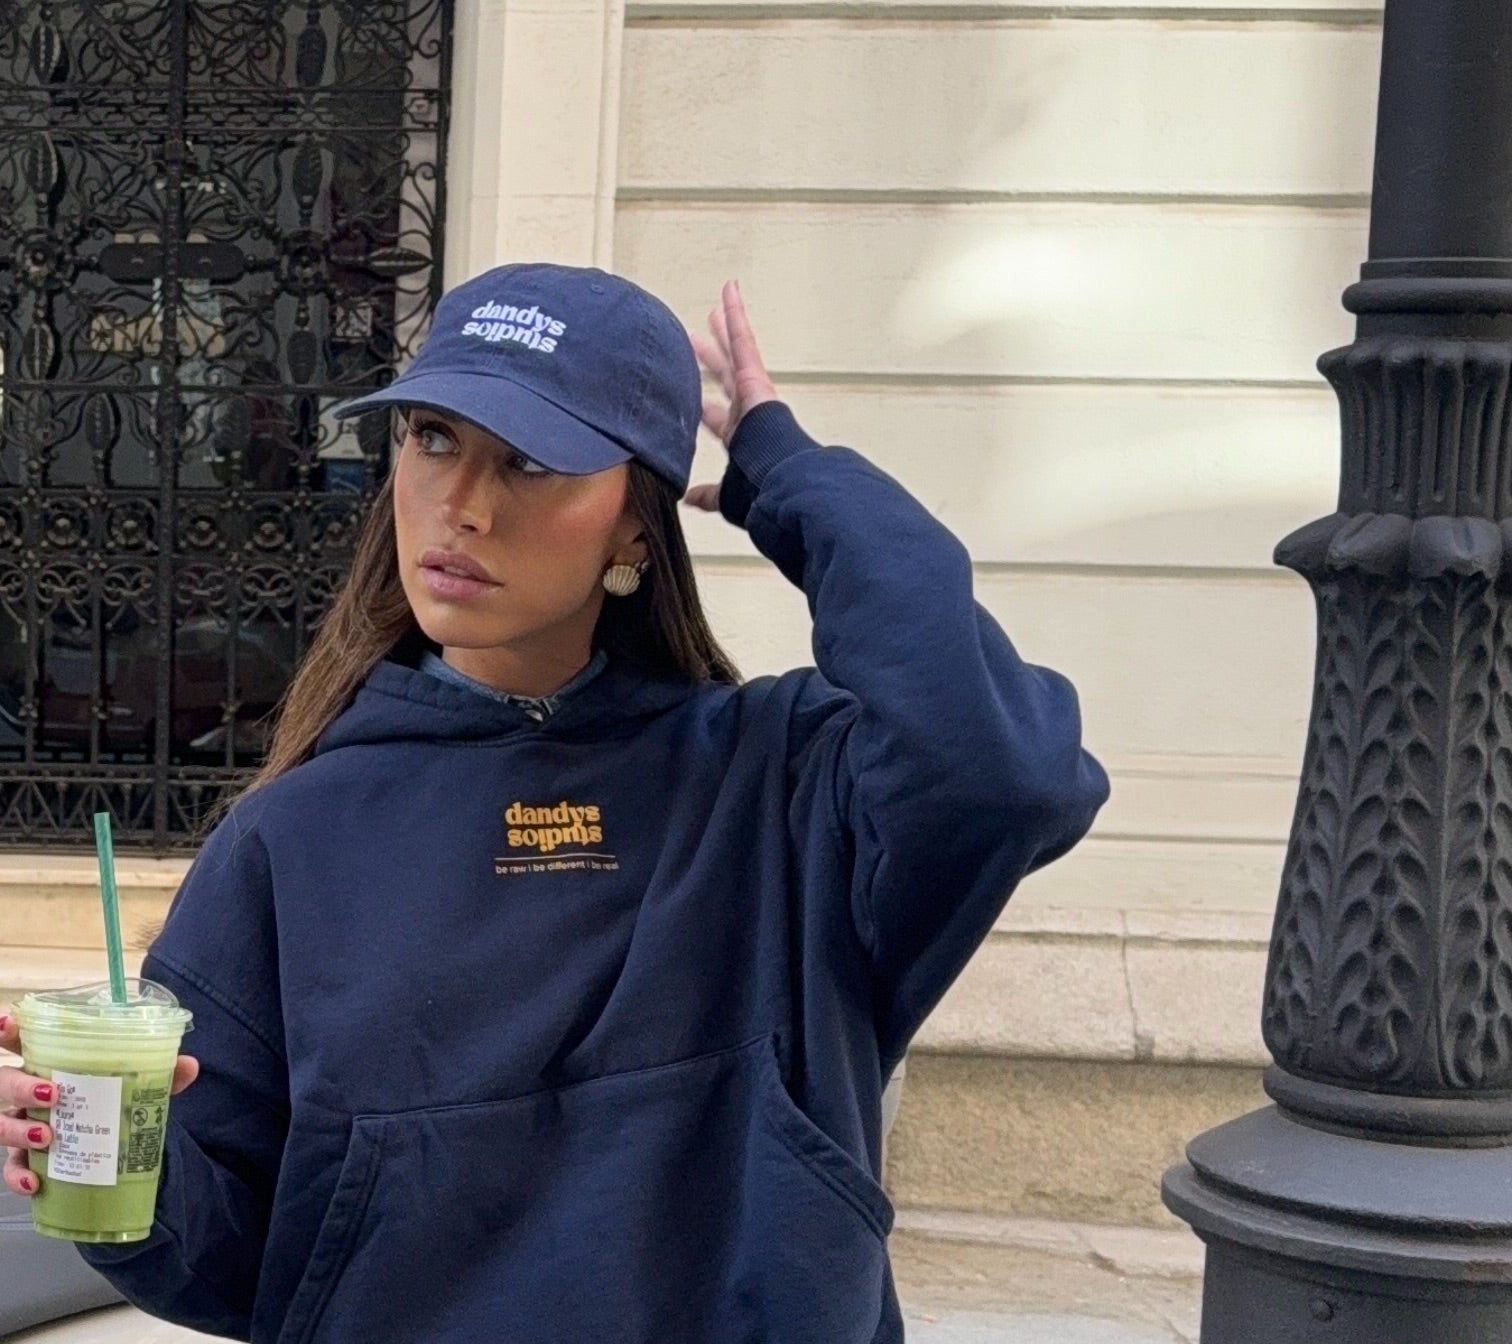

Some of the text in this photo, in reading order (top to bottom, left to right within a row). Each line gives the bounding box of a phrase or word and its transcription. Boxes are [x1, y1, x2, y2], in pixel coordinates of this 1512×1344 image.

[471, 299, 567, 337] dandys
[504, 800, 601, 827] dandys
[495, 864, 509, 875] be
[532, 862, 546, 873] be
